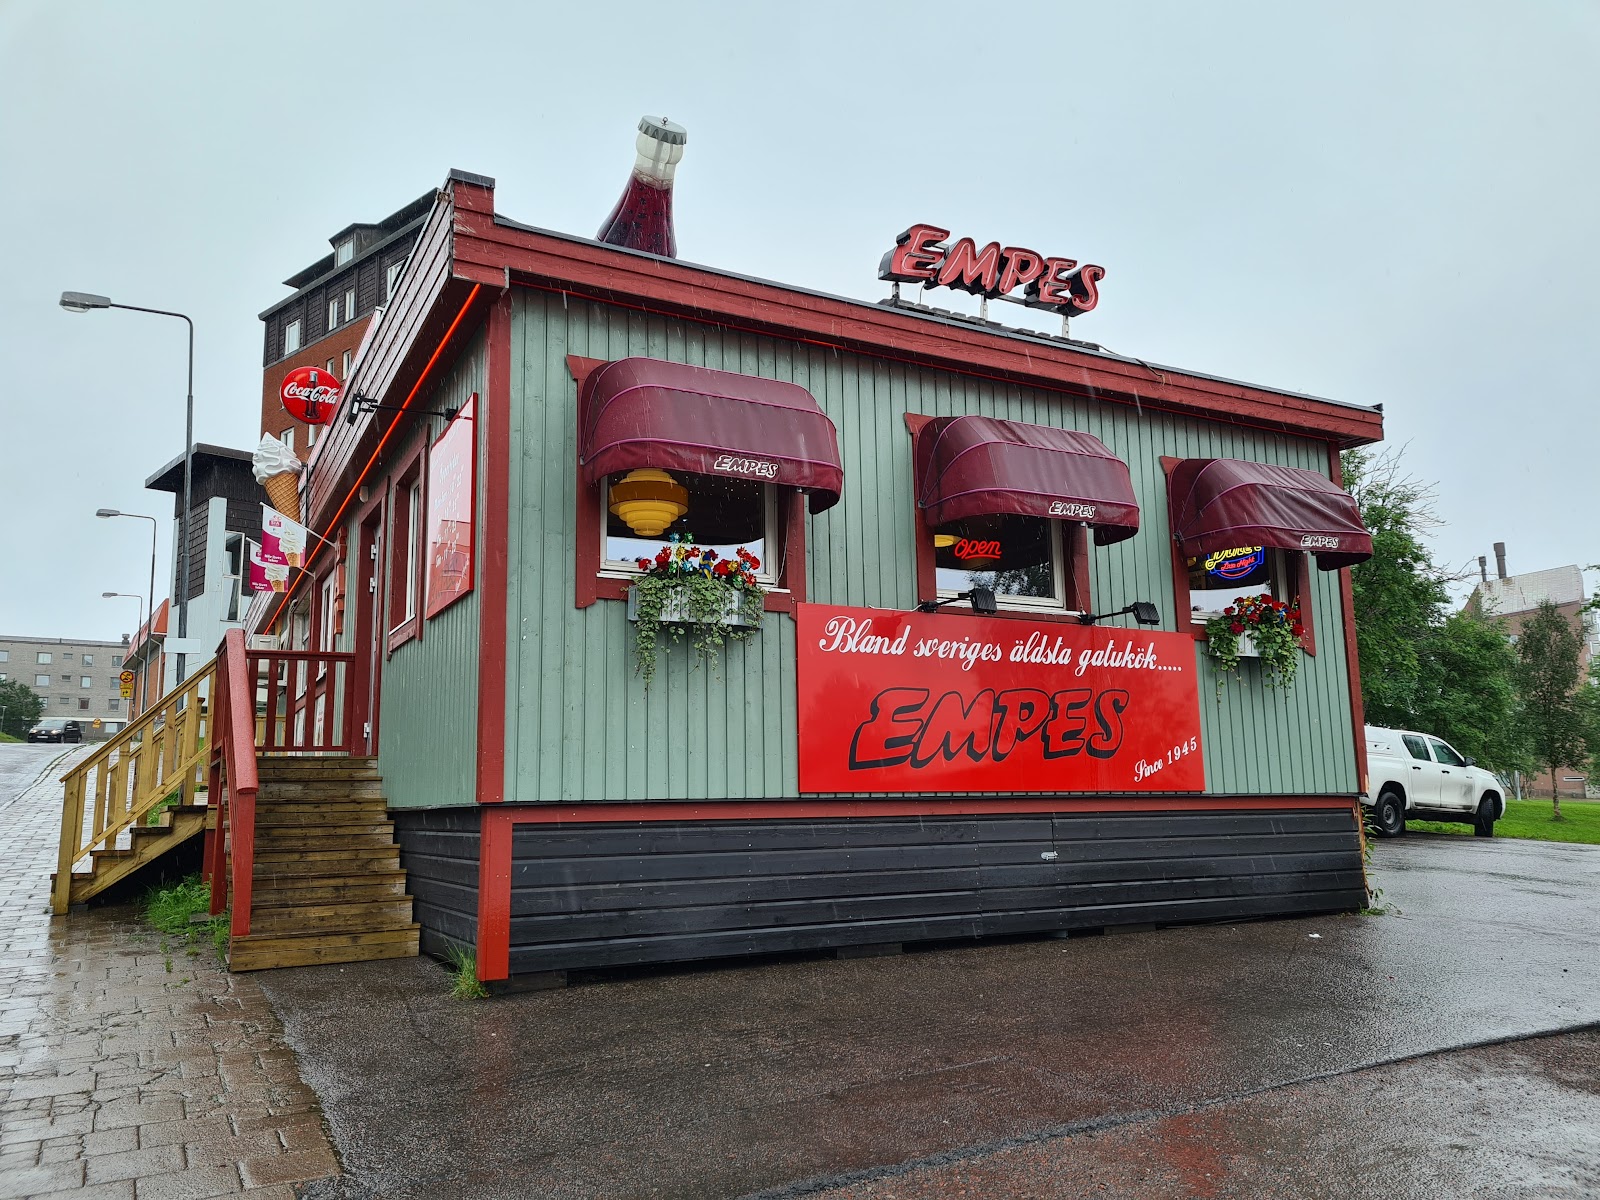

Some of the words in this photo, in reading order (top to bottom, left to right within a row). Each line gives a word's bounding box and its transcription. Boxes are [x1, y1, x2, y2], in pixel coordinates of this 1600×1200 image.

[889, 223, 1106, 313] EMPES
[283, 381, 340, 405] Coca-Cola
[713, 455, 779, 478] EMPES
[1050, 501, 1096, 519] EMPES
[1300, 535, 1339, 548] EMPES
[818, 616, 912, 655] Bland
[913, 637, 1002, 671] sveriges
[1009, 631, 1071, 665] äldsta
[848, 687, 1130, 771] EMPES
[1133, 758, 1163, 782] Since
[1166, 736, 1197, 766] 1945
